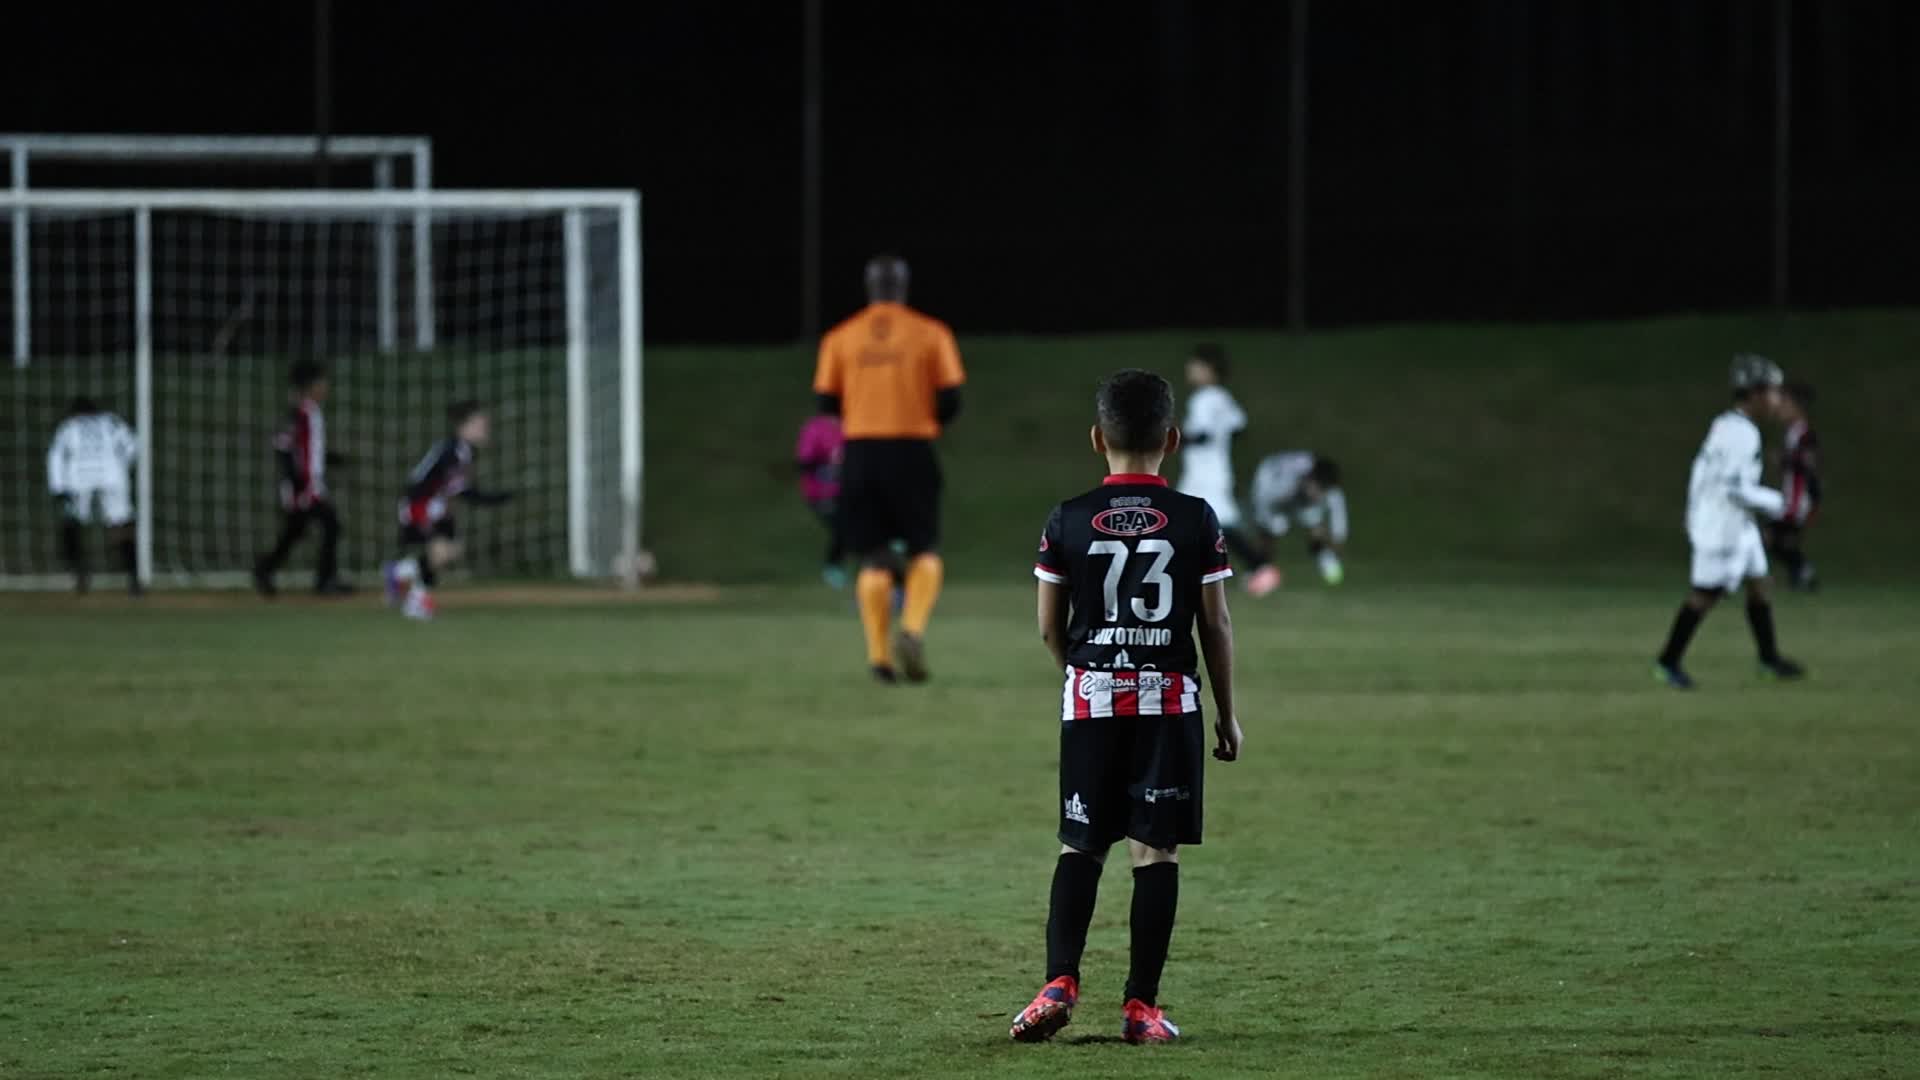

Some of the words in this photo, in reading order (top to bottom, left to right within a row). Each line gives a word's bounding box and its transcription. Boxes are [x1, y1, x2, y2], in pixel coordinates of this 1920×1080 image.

[1110, 496, 1151, 507] GRUPO
[1088, 539, 1175, 622] 73
[1115, 625, 1172, 646] OTÁVIO
[1096, 678, 1136, 687] PARDAL
[1139, 676, 1172, 686] GESSO
